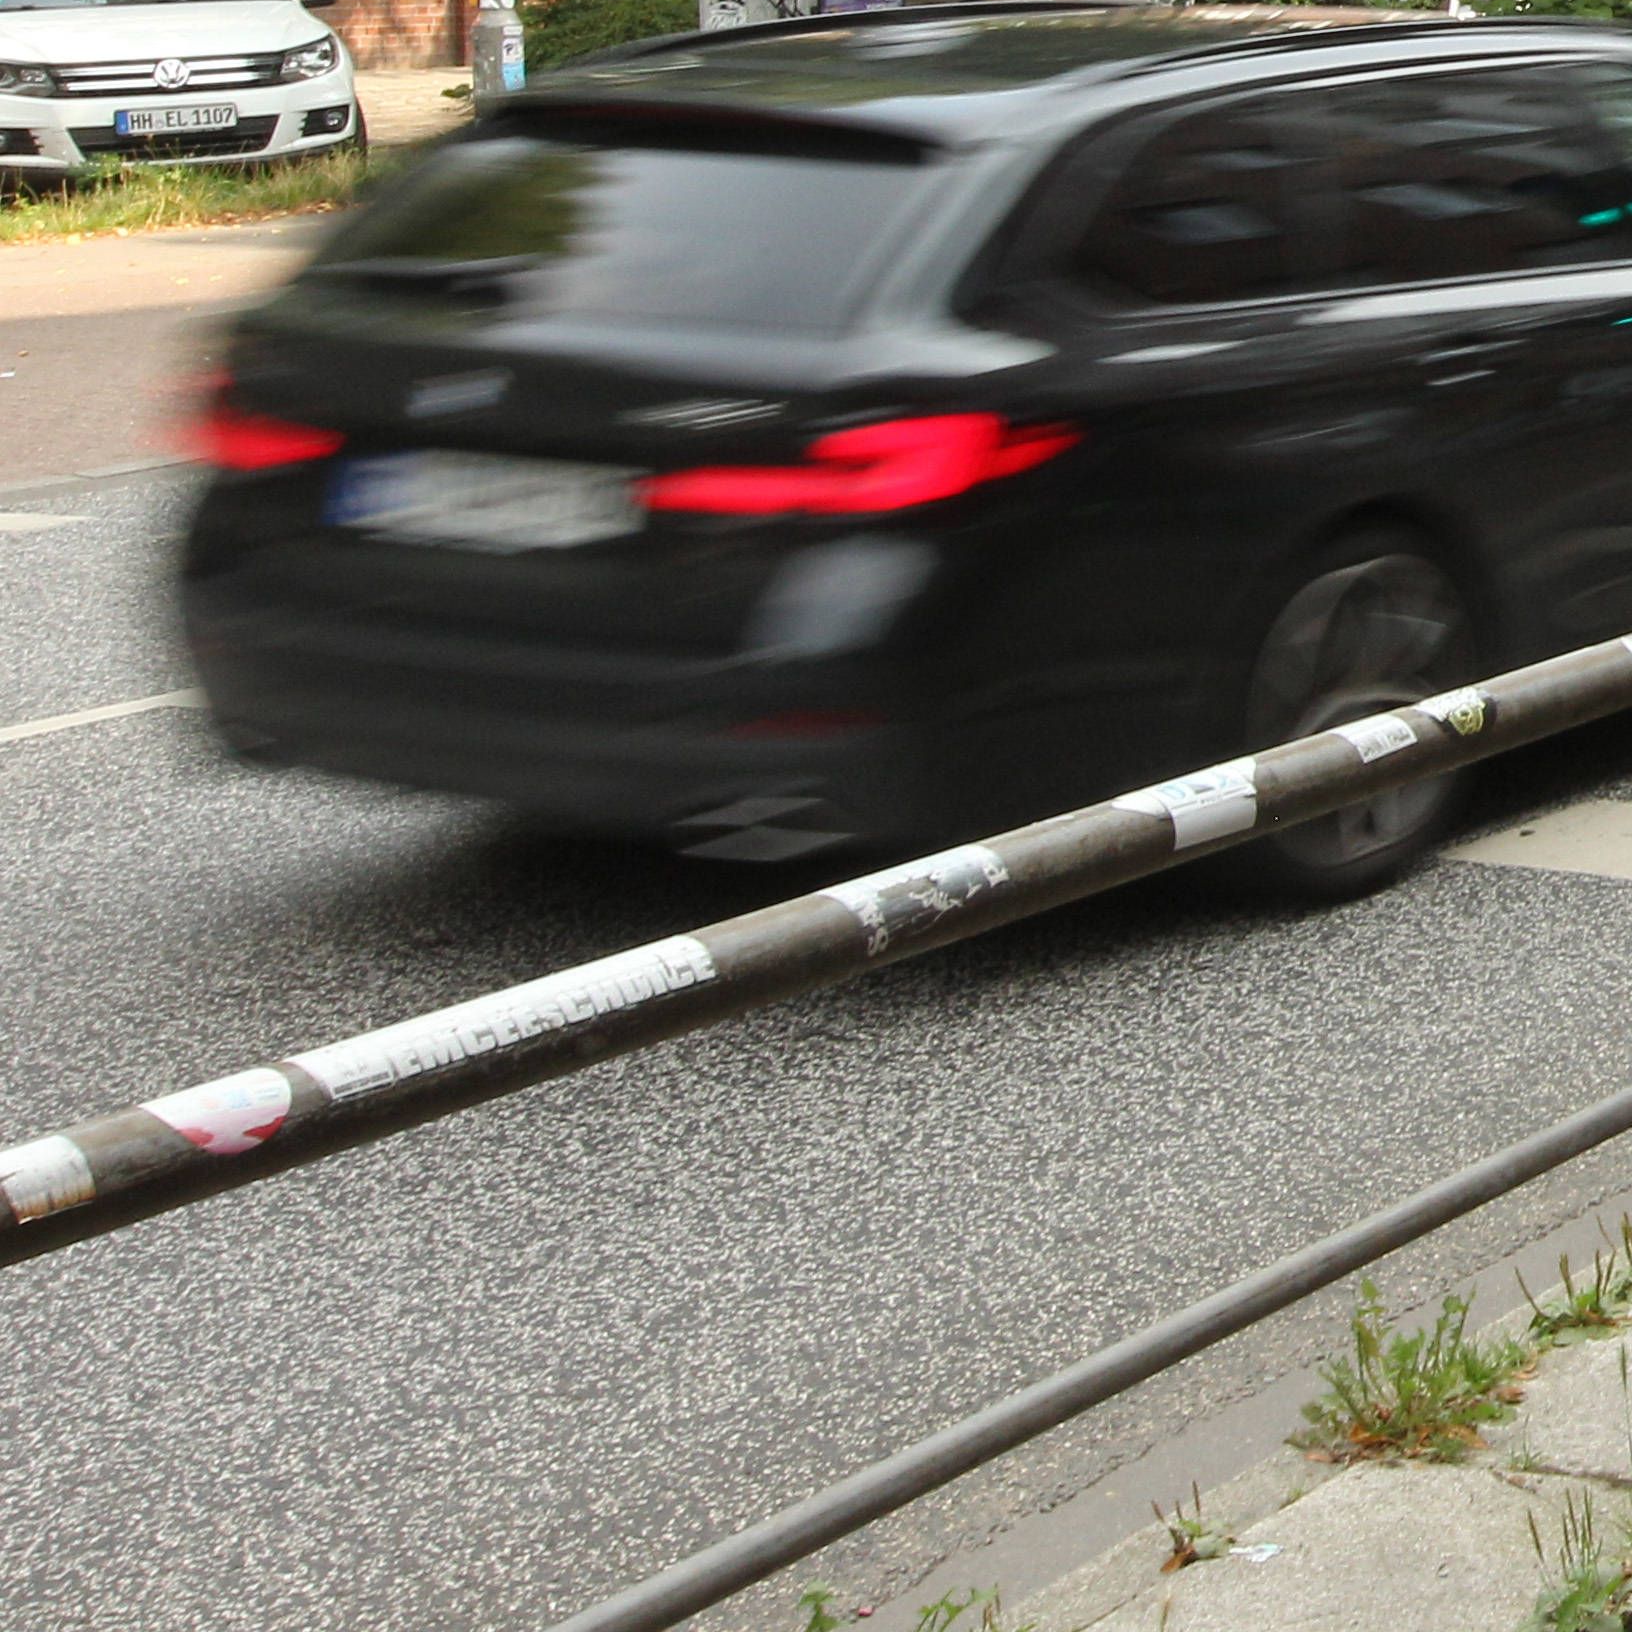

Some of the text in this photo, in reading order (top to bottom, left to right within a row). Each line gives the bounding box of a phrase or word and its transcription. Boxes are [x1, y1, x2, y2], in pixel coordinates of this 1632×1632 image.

[130, 107, 234, 131] HH EL 1107
